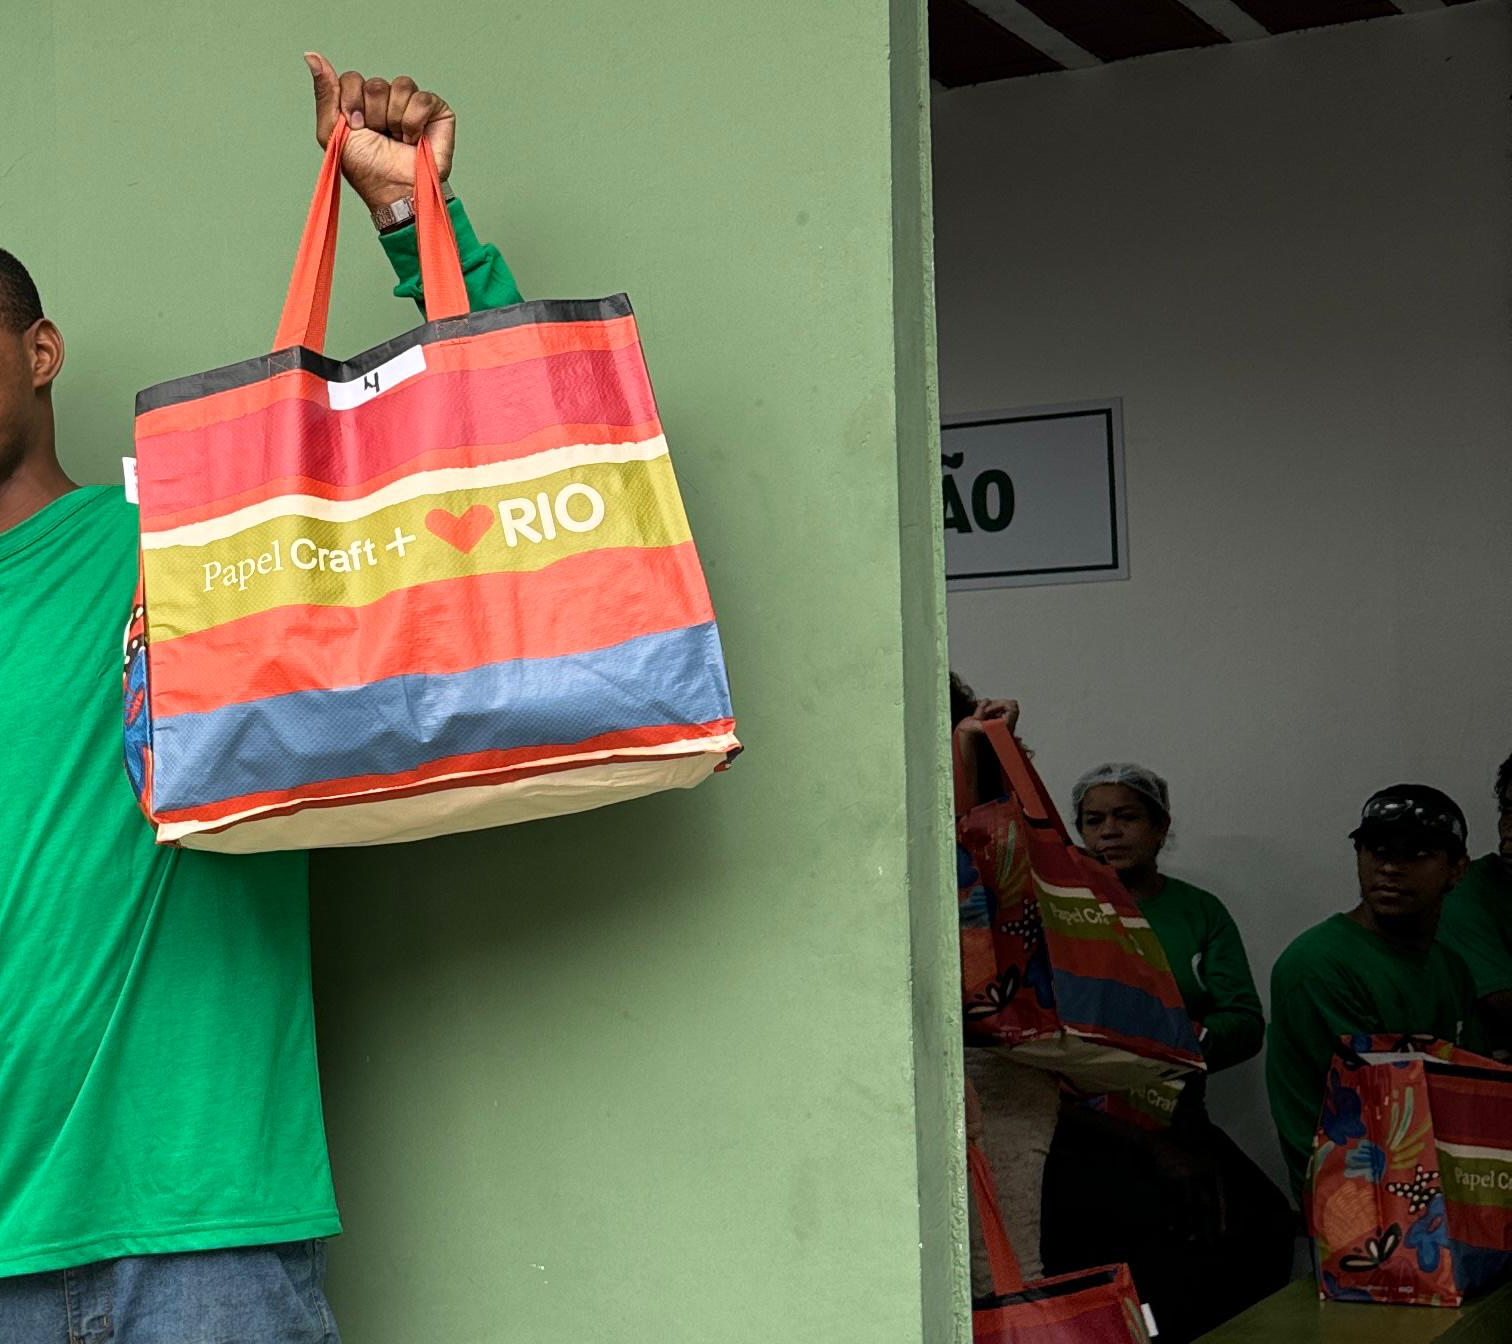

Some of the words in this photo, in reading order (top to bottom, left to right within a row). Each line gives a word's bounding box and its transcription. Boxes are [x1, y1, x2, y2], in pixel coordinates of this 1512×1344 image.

[202, 538, 284, 593] Papel
[290, 537, 377, 574] Craft
[498, 482, 605, 548] RIO
[1454, 1166, 1495, 1191] Papel
